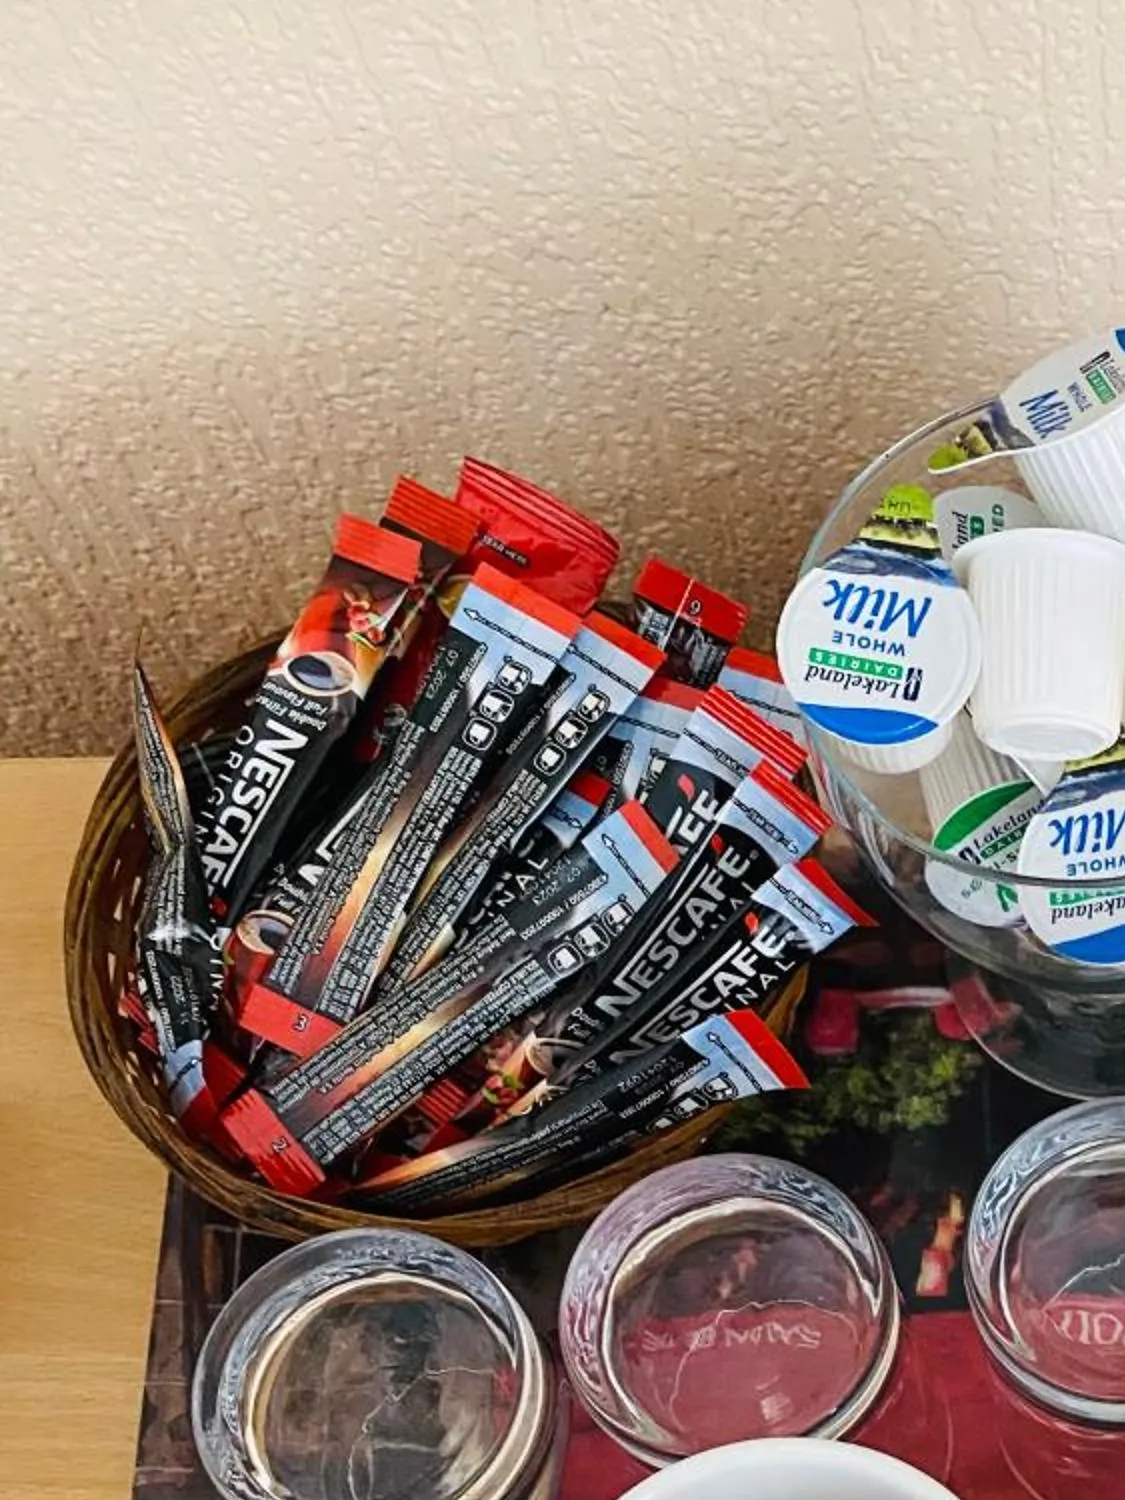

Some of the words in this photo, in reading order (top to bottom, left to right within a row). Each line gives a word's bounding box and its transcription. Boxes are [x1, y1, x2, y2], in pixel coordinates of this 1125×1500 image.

[1019, 389, 1072, 439] Milk
[823, 579, 932, 638] Milk
[814, 650, 899, 677] DAIRIES
[832, 630, 905, 656] WHOLE
[804, 665, 901, 699] Lakeland
[195, 725, 254, 844] ORIGIN
[199, 718, 308, 895] NESCAF
[596, 836, 752, 1018] NESCAFÉ
[290, 1010, 311, 1034] 3
